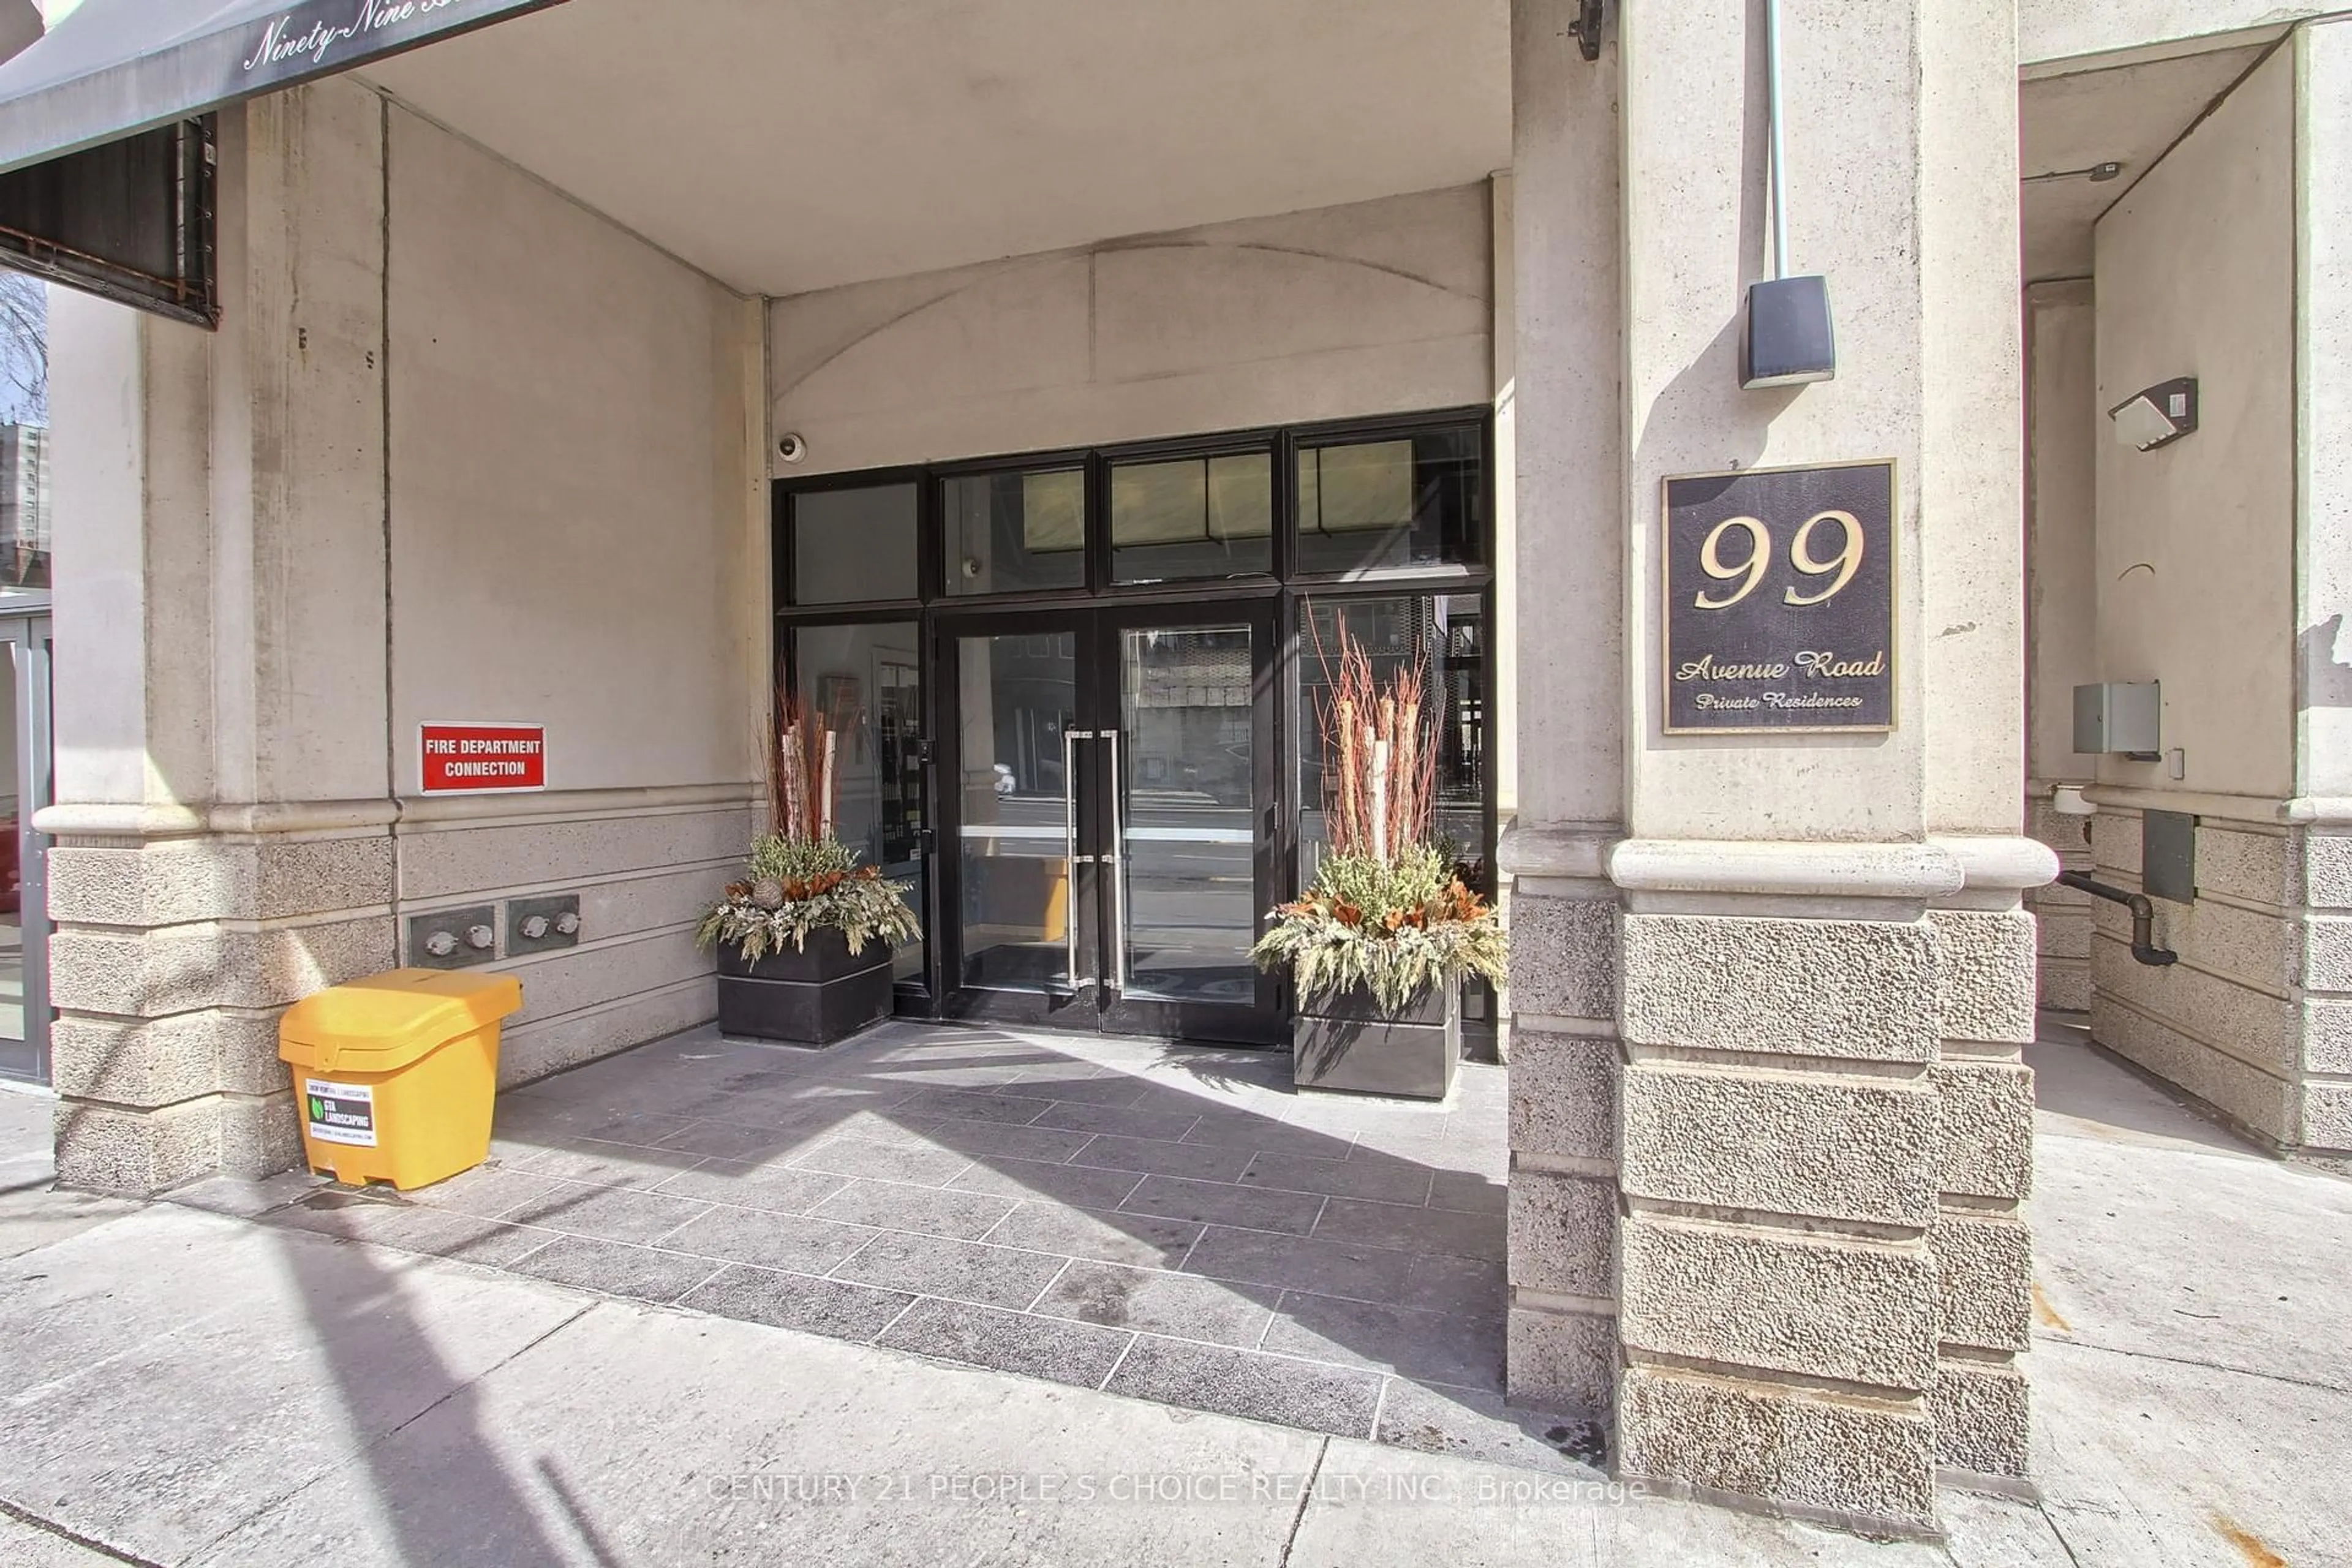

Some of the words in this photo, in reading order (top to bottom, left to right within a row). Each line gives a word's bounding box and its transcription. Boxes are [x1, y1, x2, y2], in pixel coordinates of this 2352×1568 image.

[1694, 510, 1864, 609] 99
[1675, 654, 1791, 680] Avenue
[1793, 650, 1885, 678] Road
[1695, 693, 1761, 709] Private
[1762, 692, 1863, 709] Residences
[426, 739, 456, 755] FIRE
[461, 739, 541, 755] DEPARTMENT
[445, 761, 526, 777] CONNECTION
